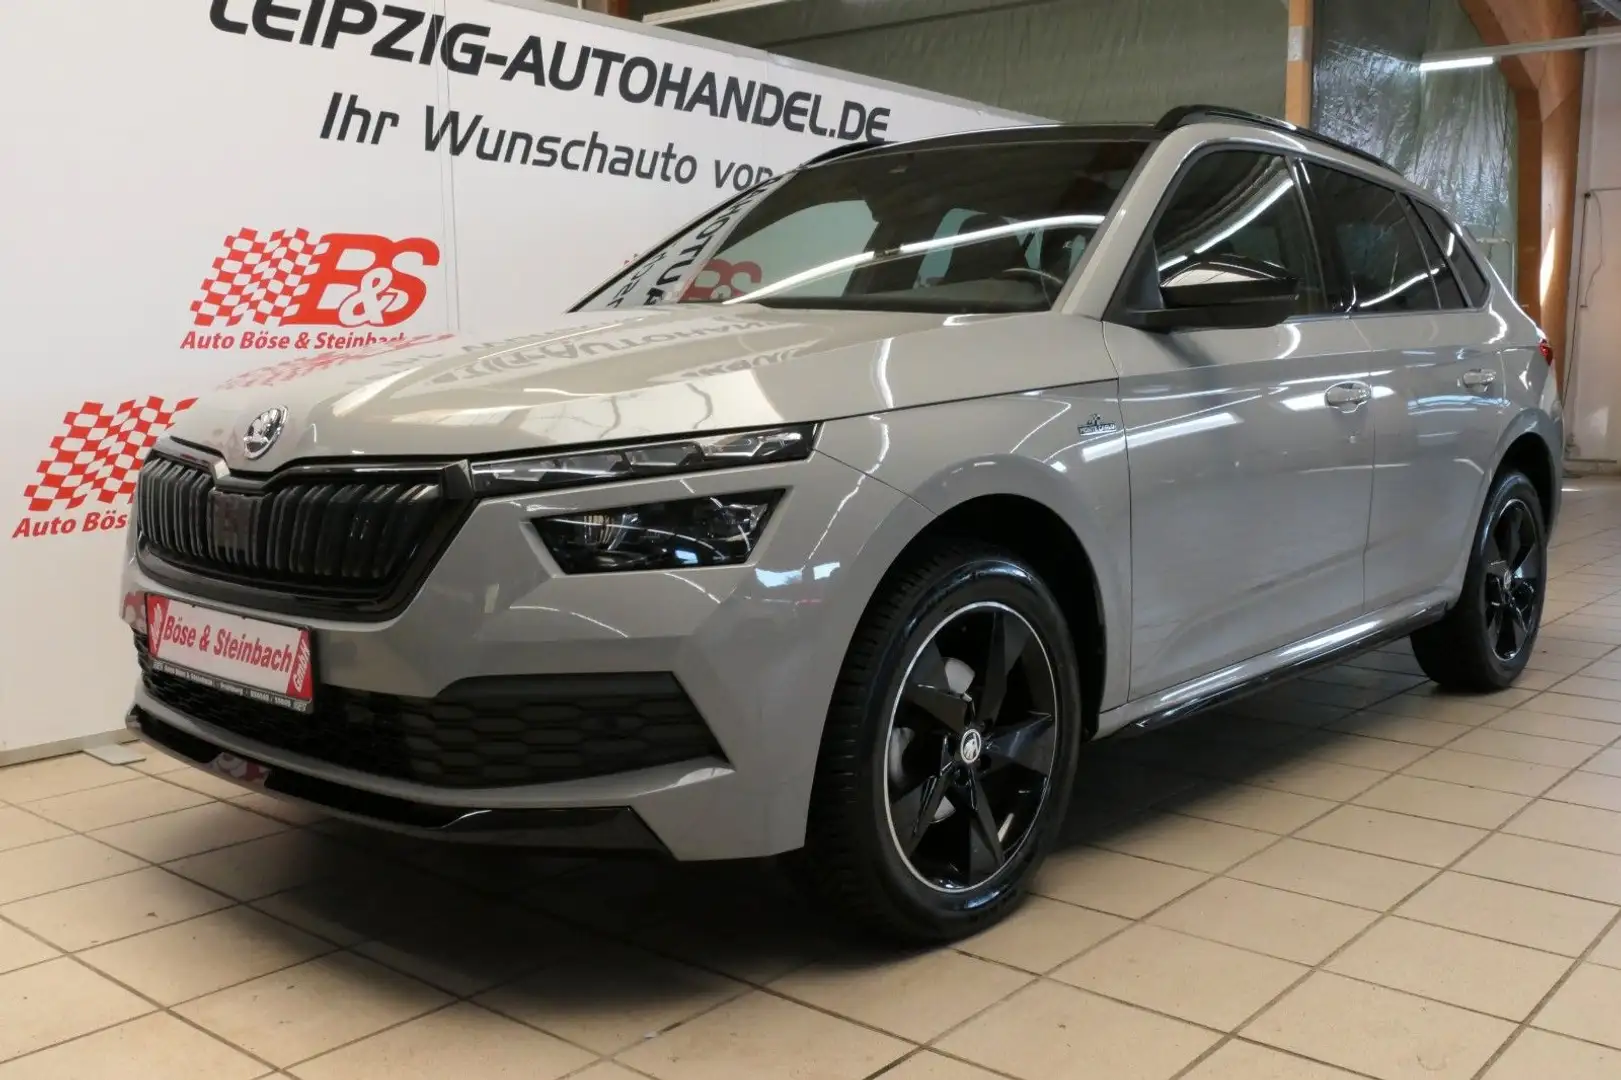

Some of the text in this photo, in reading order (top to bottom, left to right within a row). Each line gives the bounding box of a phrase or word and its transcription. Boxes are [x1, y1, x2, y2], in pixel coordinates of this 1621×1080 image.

[210, 0, 891, 142] LEIPZIG-AUTOHANDEL.DE
[320, 92, 399, 145] Ihr
[425, 104, 697, 184] Wunschauto
[180, 331, 235, 349] Auto
[240, 330, 290, 349] Böse
[294, 332, 310, 349] &
[12, 509, 130, 538] Auto Bös
[162, 615, 197, 648] Böse
[198, 624, 211, 652] &
[213, 628, 294, 673] Steinbach
